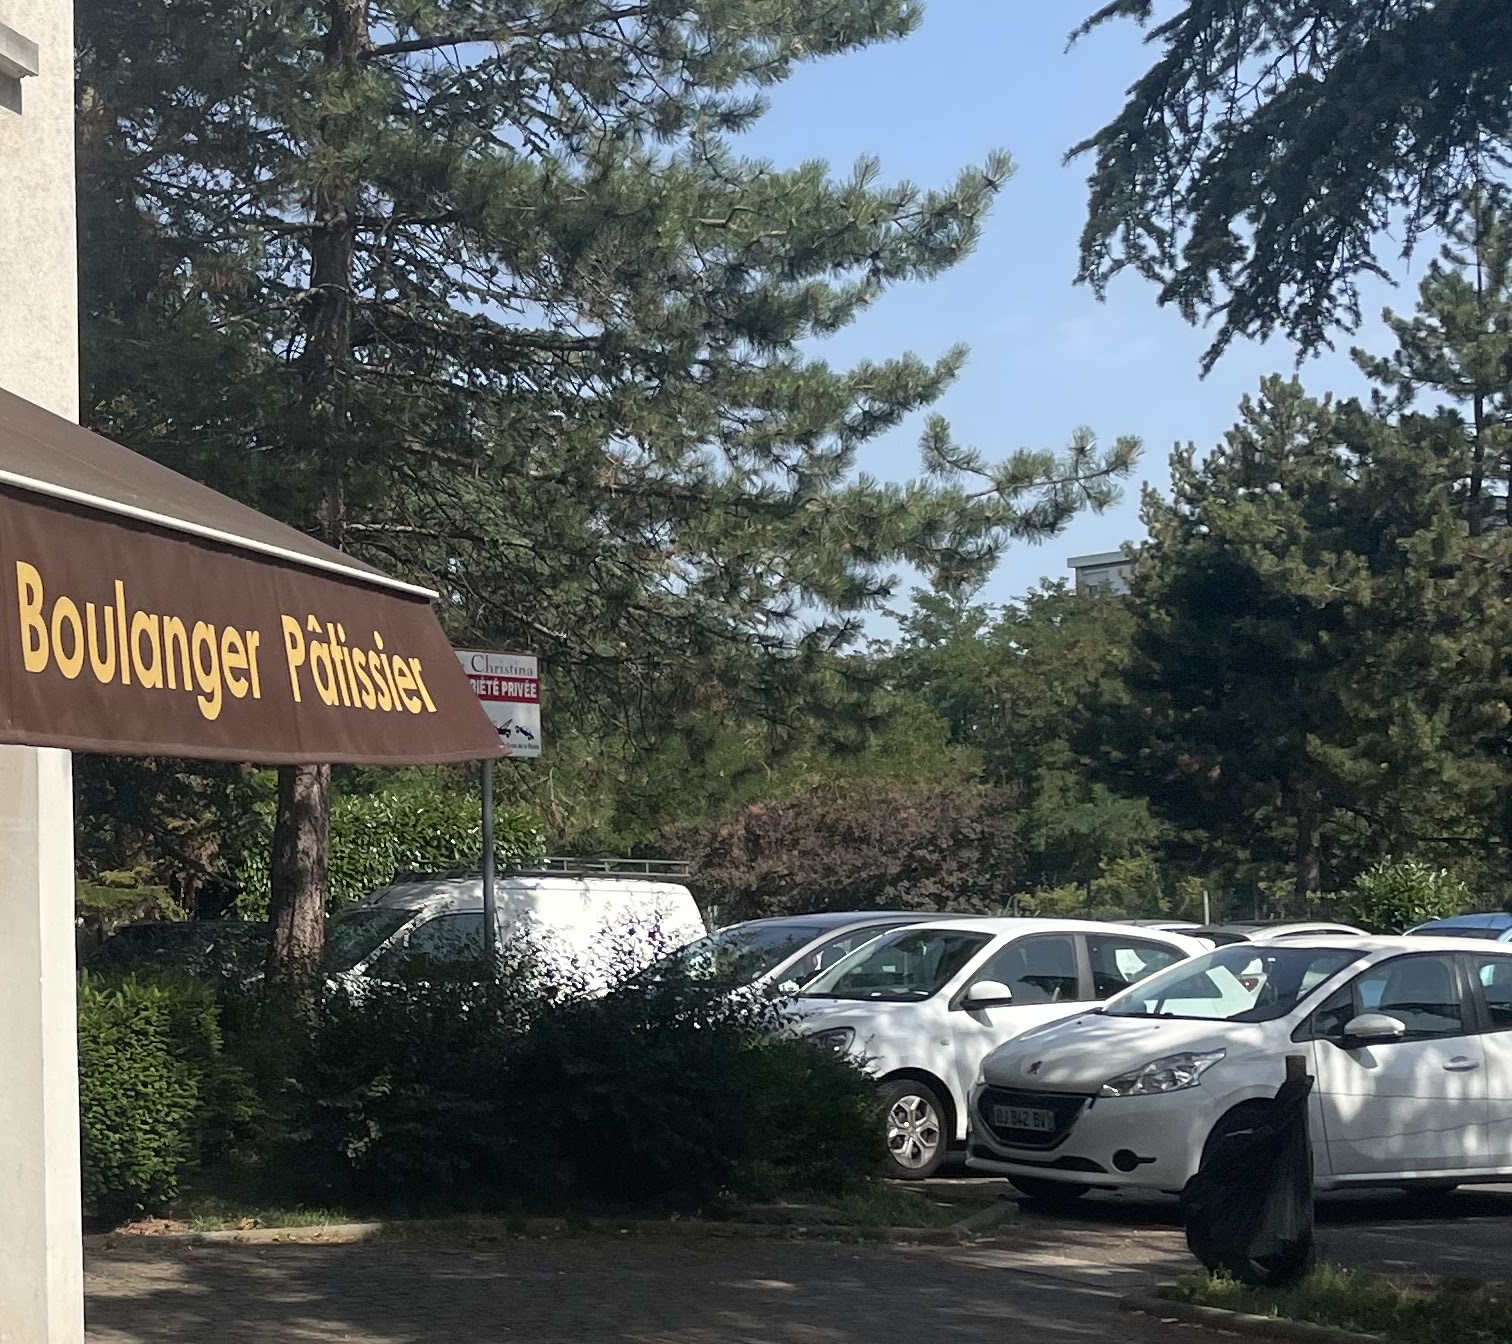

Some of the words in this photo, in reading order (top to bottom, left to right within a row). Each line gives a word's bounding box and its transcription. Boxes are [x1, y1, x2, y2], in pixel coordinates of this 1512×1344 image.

[16, 560, 261, 720] Boulanger
[280, 613, 437, 714] Pâtissier
[471, 654, 533, 676] Christina
[501, 680, 537, 698] PRIVÉE
